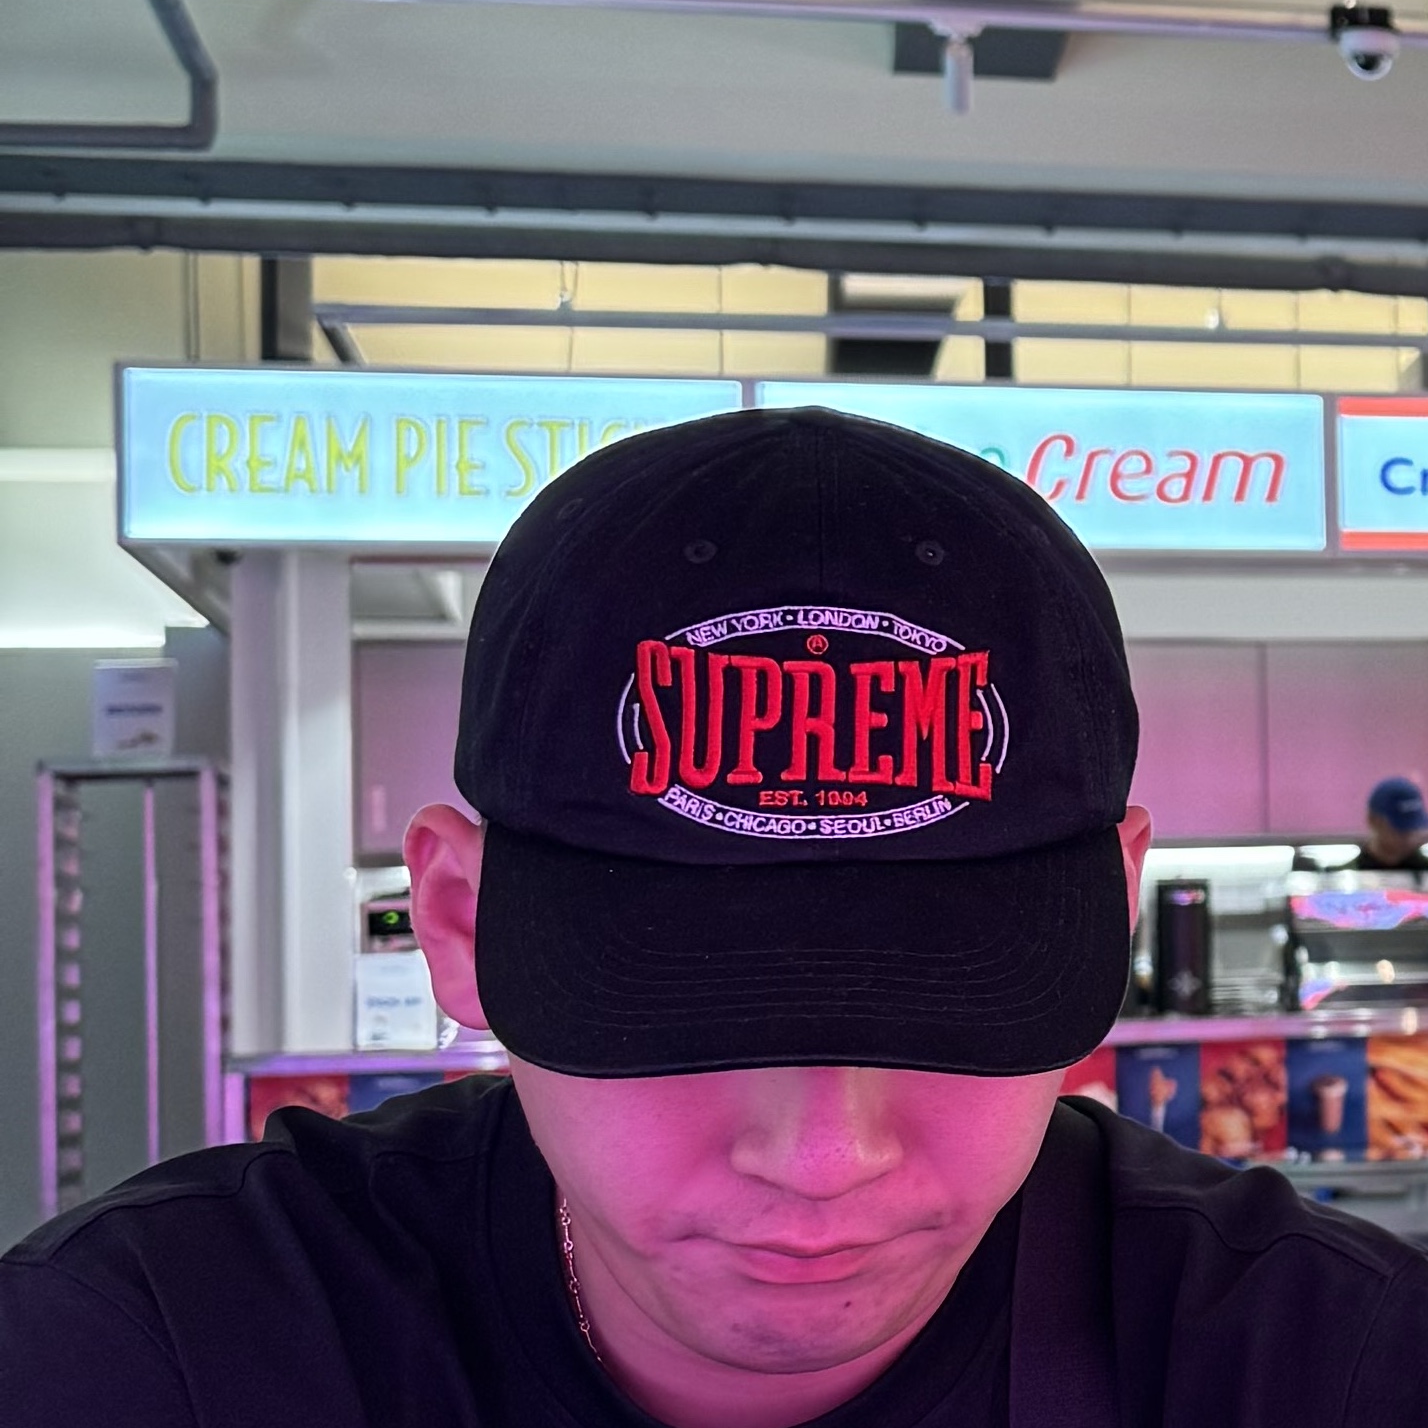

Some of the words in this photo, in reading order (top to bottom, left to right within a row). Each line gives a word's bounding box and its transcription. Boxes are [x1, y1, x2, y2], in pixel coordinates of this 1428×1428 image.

[167, 412, 371, 496] CREAM
[395, 413, 490, 497] PIE
[1026, 433, 1286, 504] Cream
[686, 620, 728, 645] NEW
[732, 611, 785, 633] YORK
[796, 609, 880, 630] LONDON
[892, 619, 948, 654] TOKYO
[628, 639, 993, 803] SUPREME
[663, 786, 715, 823] PARIS
[722, 810, 807, 835] CHICAGO
[818, 814, 886, 836] SEOUL
[893, 795, 953, 829] BERLIN
